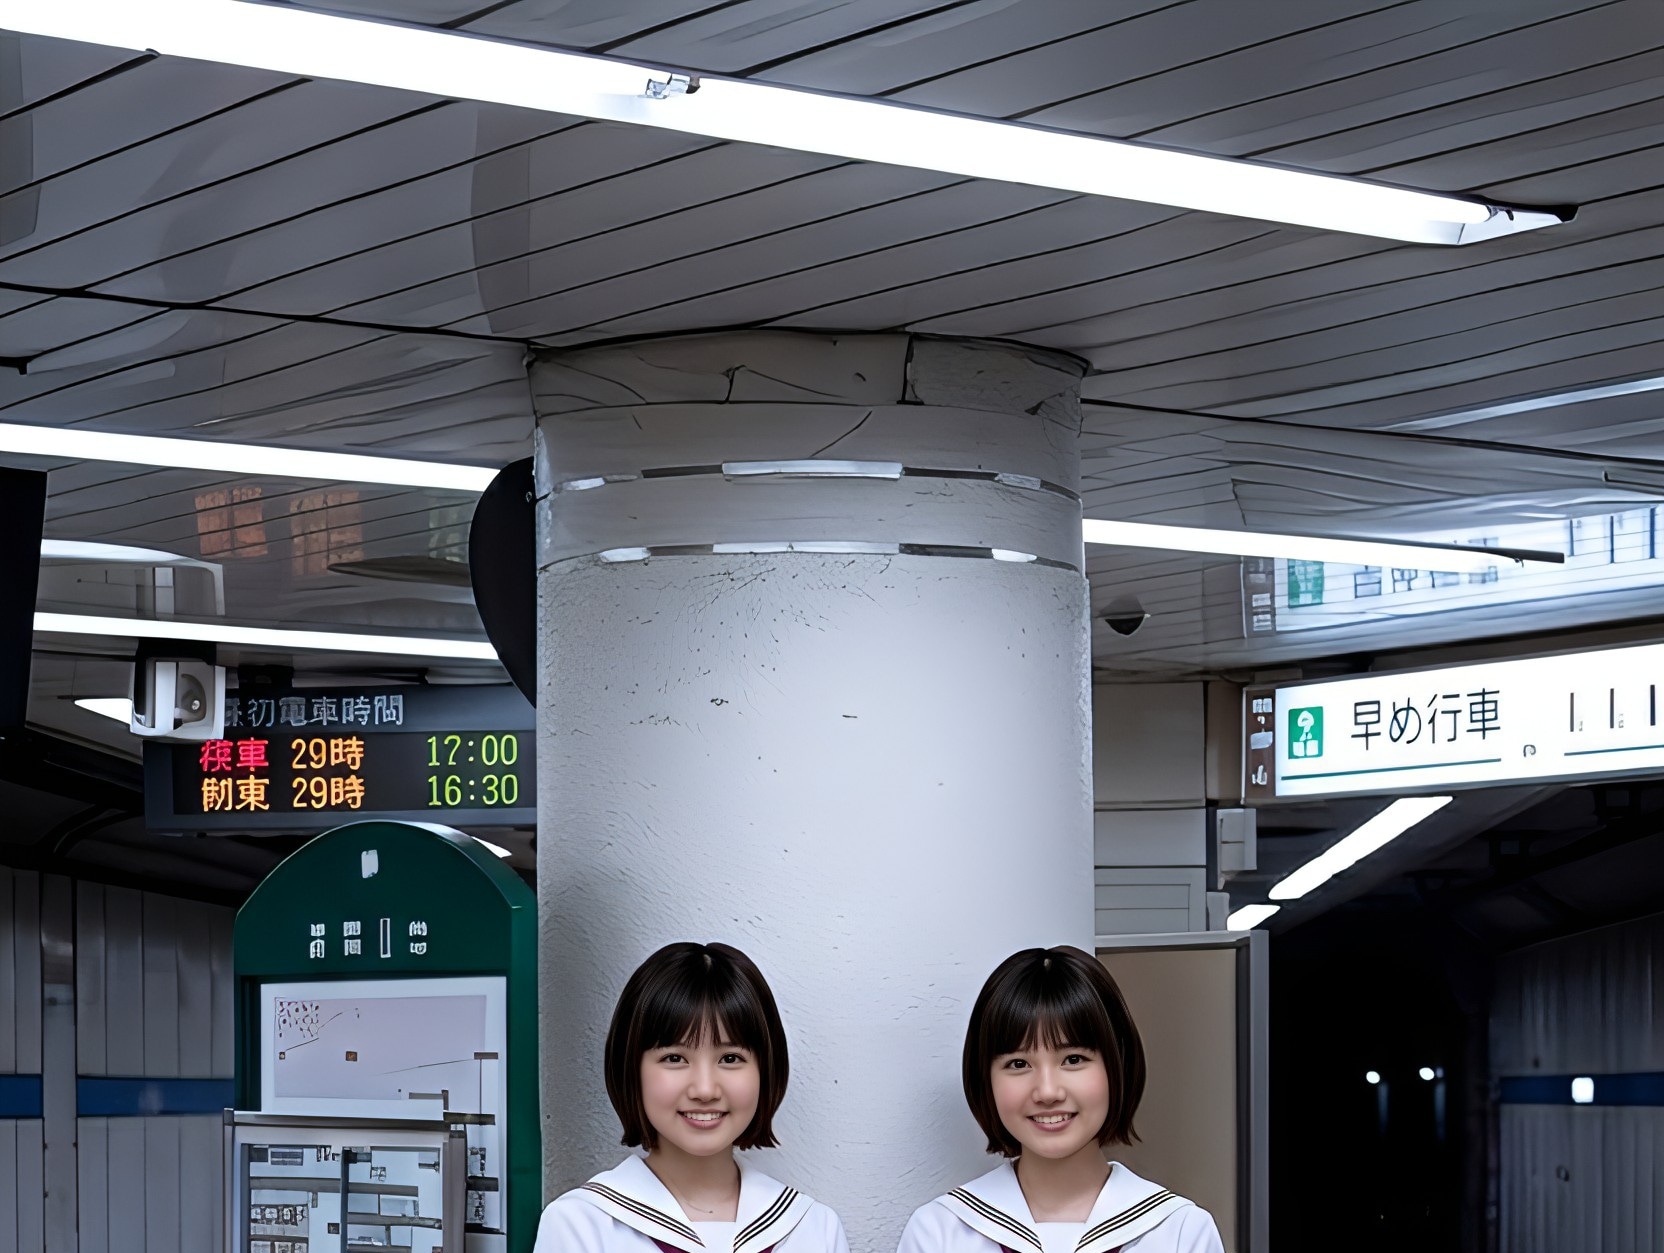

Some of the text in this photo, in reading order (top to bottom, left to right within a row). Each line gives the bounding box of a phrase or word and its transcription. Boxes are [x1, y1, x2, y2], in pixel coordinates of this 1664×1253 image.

[1350, 687, 1501, 751] 早め行車
[291, 735, 366, 771] 29時
[427, 734, 518, 767] 17:00
[292, 775, 366, 809] 29時
[427, 774, 519, 806] 16:30
